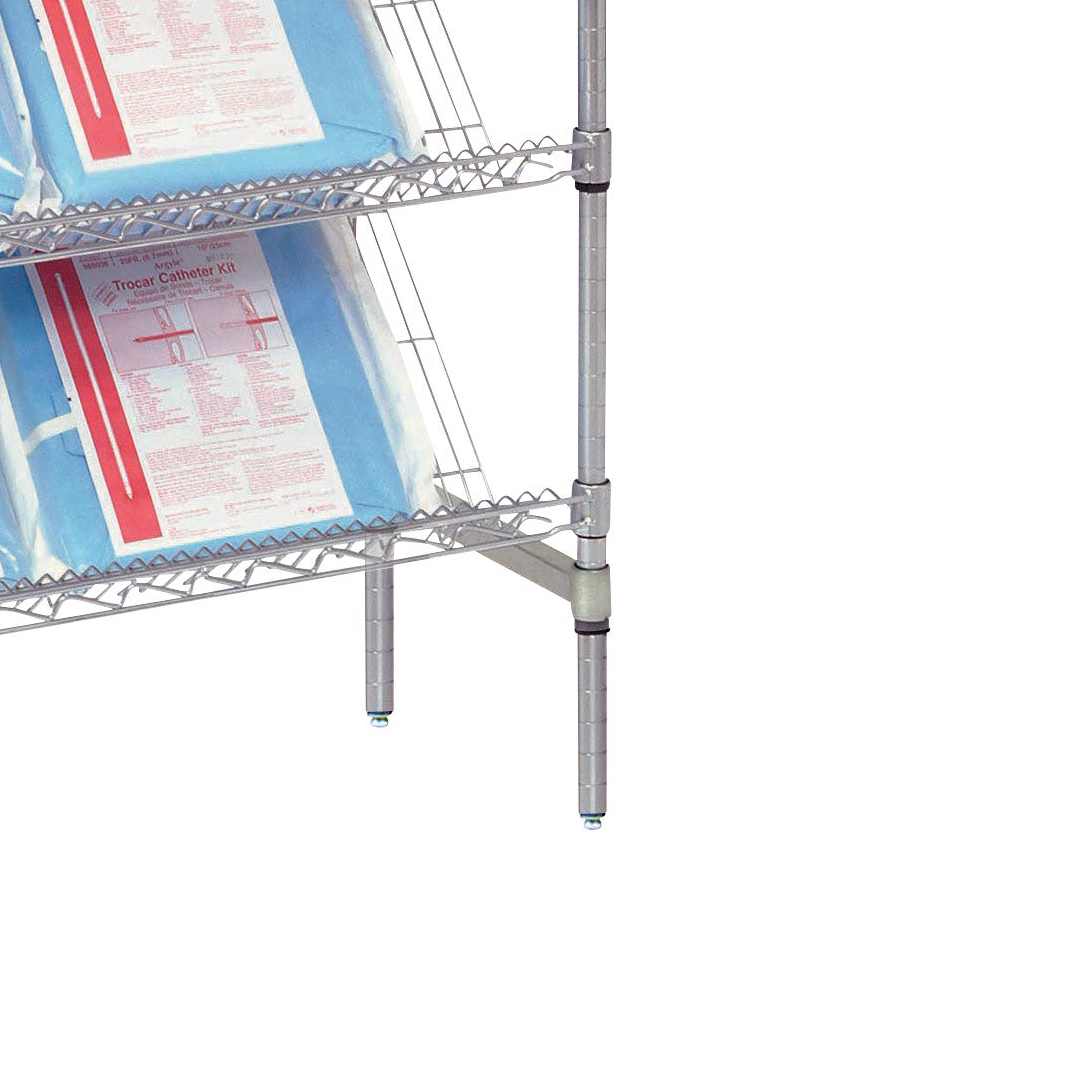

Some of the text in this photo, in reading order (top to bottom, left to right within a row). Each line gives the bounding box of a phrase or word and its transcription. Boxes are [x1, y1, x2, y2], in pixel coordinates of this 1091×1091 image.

[154, 257, 180, 270] Argyle
[112, 261, 237, 292] Trocar Catheter Kit
